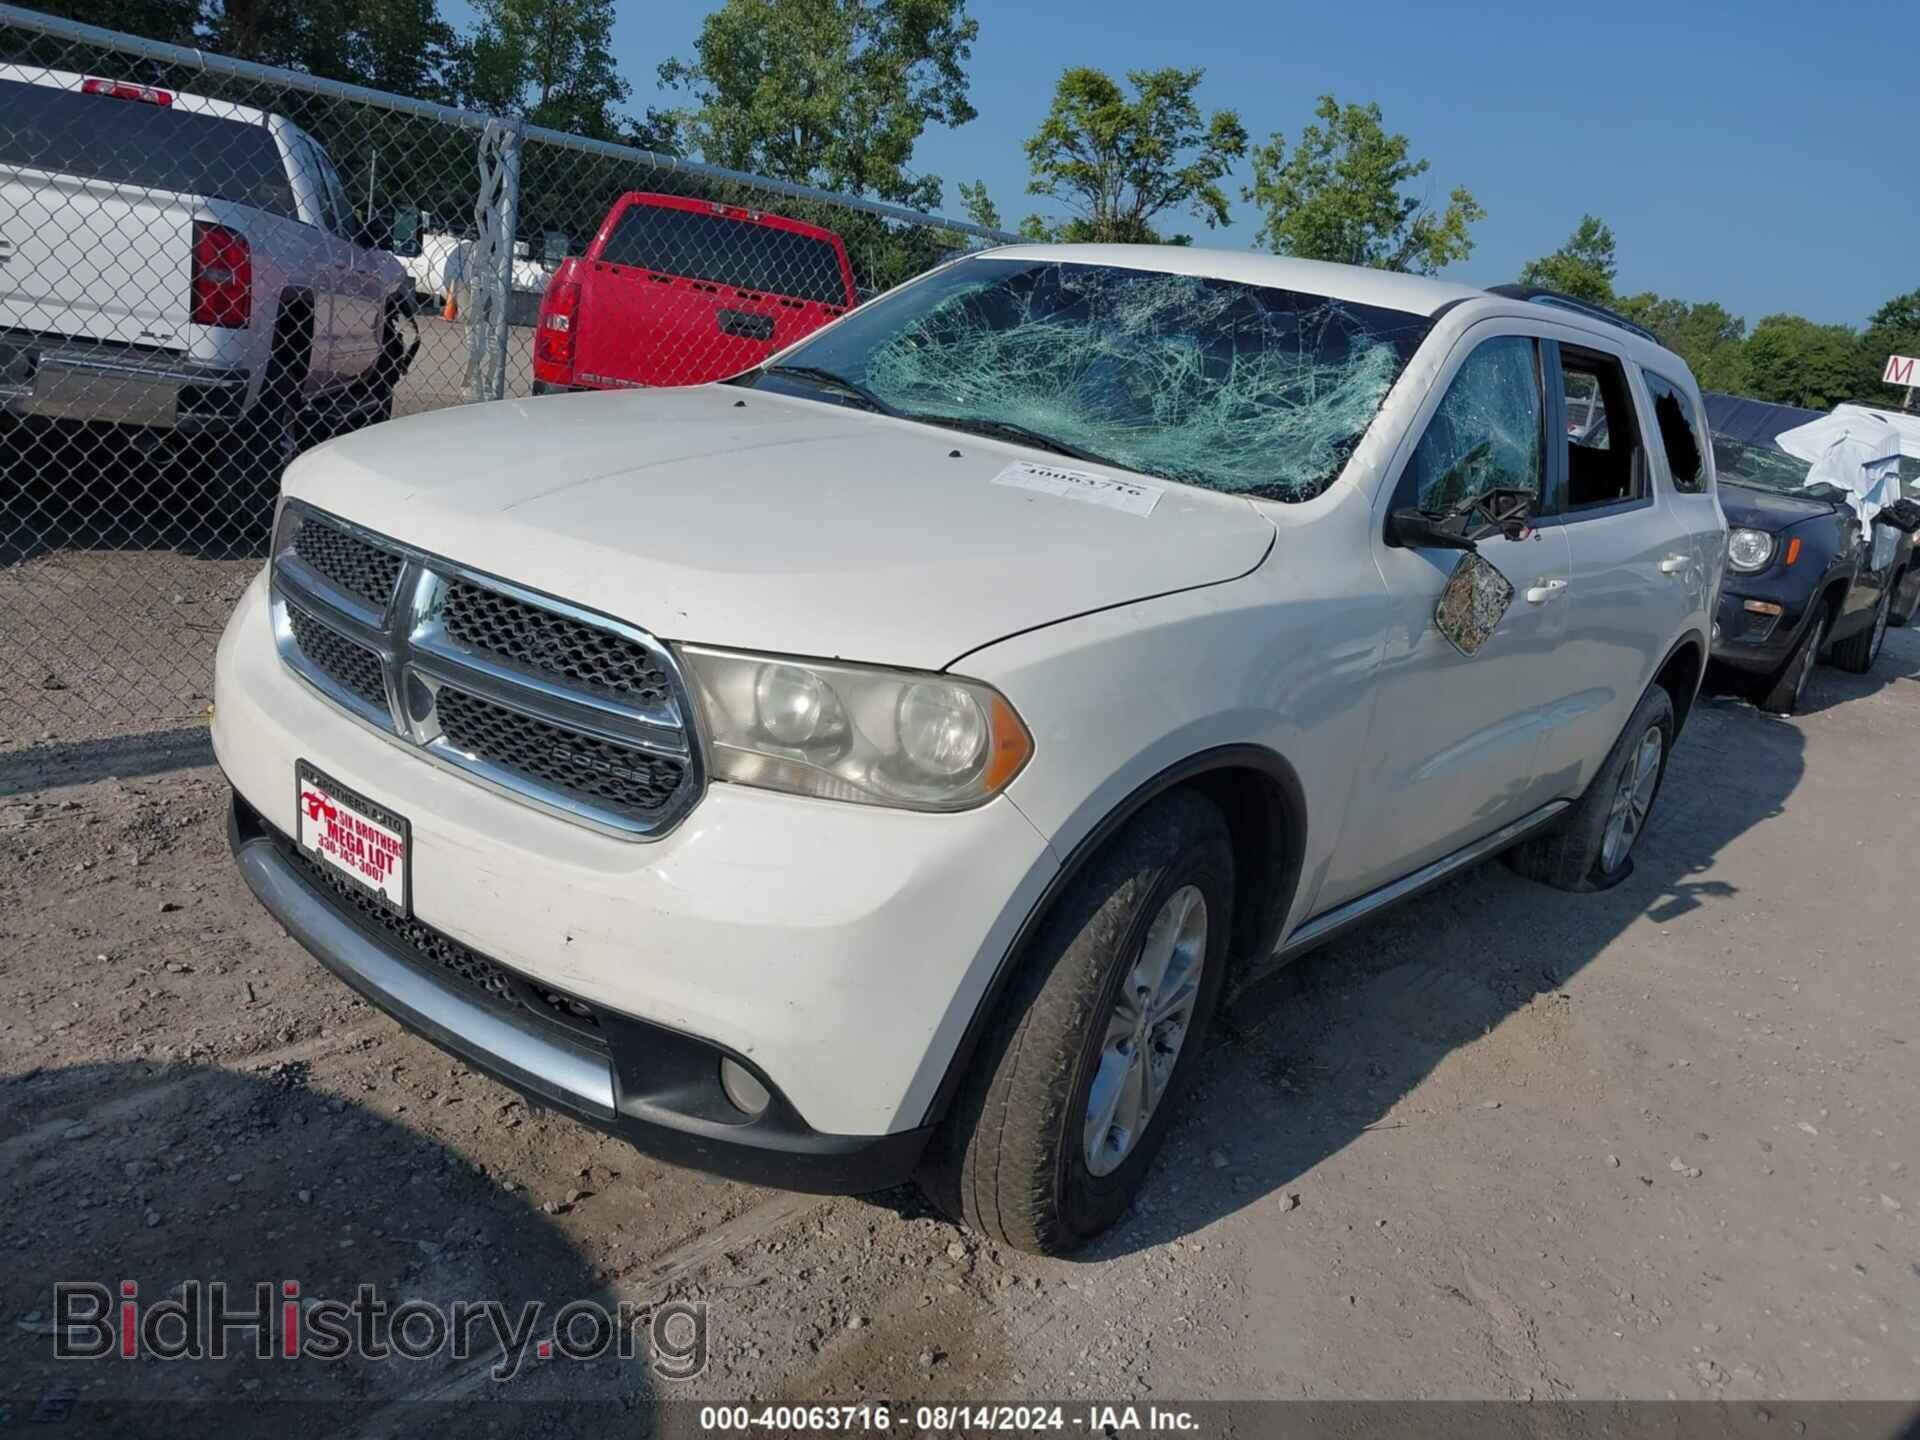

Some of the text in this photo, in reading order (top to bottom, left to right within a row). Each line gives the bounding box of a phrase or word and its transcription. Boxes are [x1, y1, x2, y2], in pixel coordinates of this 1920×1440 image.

[317, 779, 368, 815] BROTHERS
[318, 834, 384, 883] 330-743-3007
[326, 820, 395, 876] MEGA LOT
[339, 810, 405, 859] SIX BROTHERS
